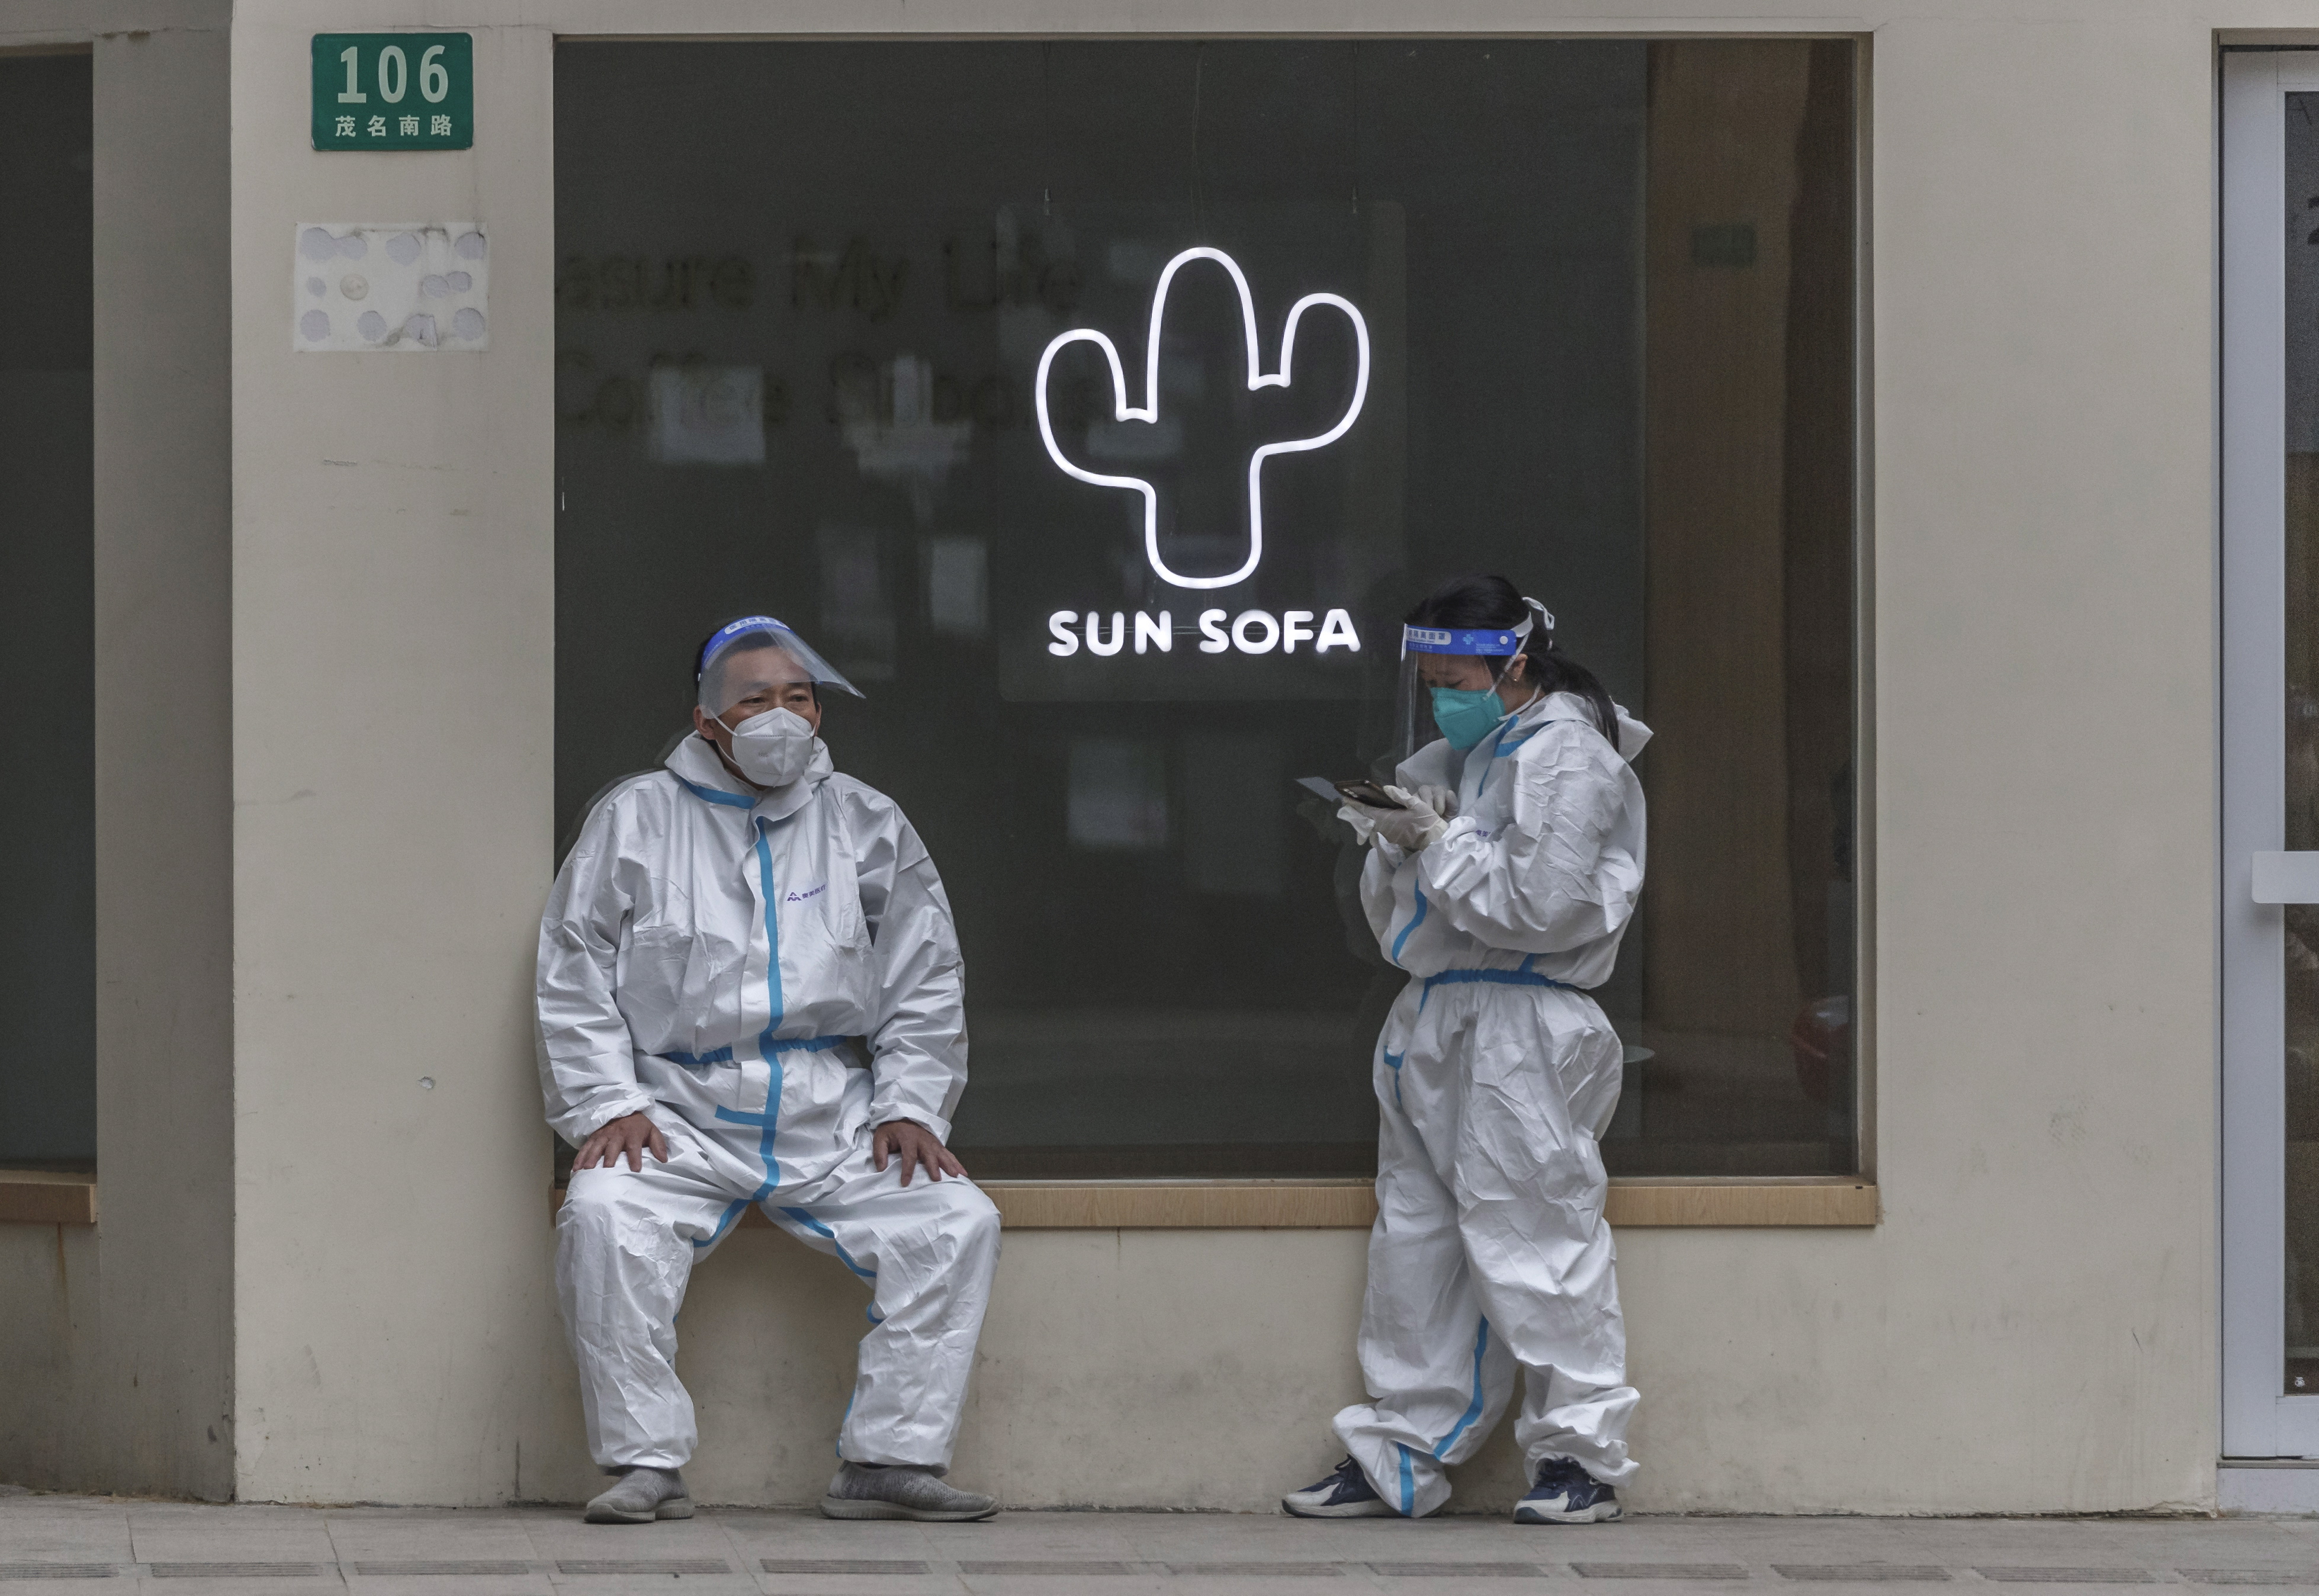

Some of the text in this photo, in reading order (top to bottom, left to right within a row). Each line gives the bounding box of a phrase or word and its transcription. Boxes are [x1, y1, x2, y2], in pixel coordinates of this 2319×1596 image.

[338, 45, 449, 103] 106
[335, 114, 452, 137] 茂名南路
[1048, 608, 1361, 657] SUN SOFA
